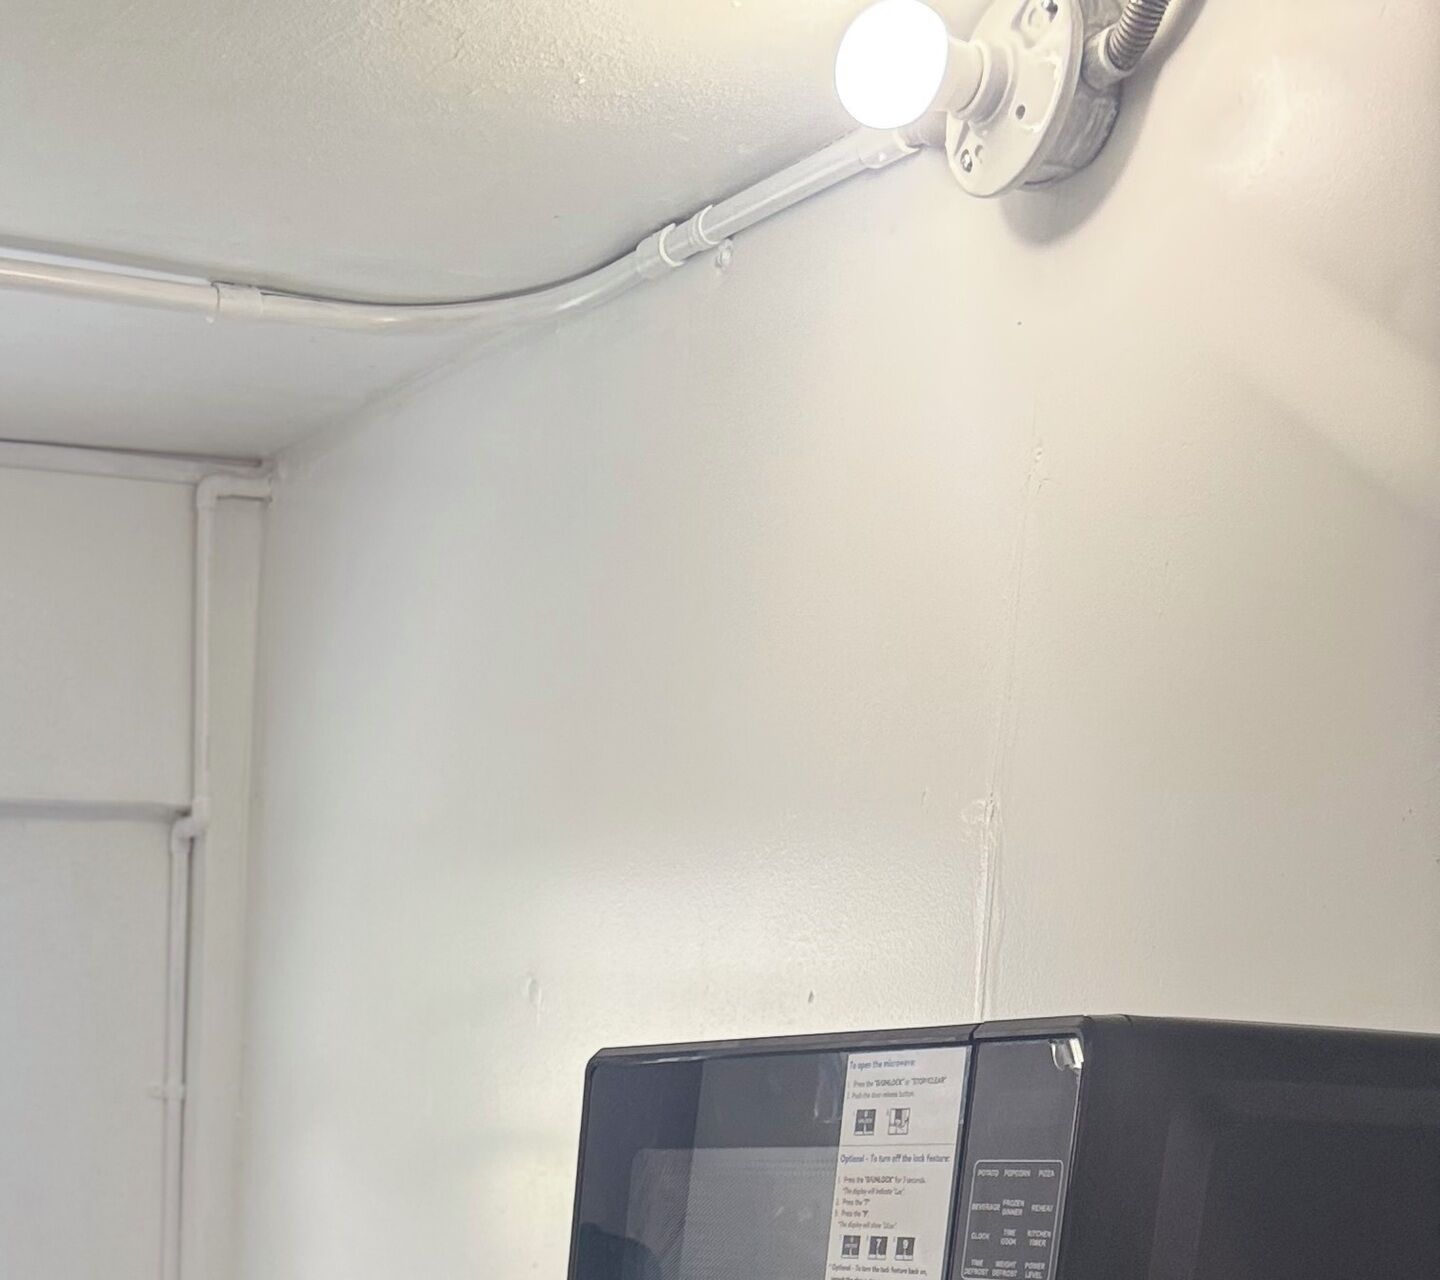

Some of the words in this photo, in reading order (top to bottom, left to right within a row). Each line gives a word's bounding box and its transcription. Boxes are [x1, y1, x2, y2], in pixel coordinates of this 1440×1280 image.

[1003, 1169, 1031, 1177] POPCORN
[971, 1203, 1001, 1211] BEVERAGE
[1002, 1199, 1025, 1207] FROZEN
[1031, 1204, 1054, 1212] REHEAT
[970, 1232, 991, 1240] CLOCK
[1027, 1229, 1052, 1238] KITCHEN
[1025, 1271, 1043, 1279] LEVEL
